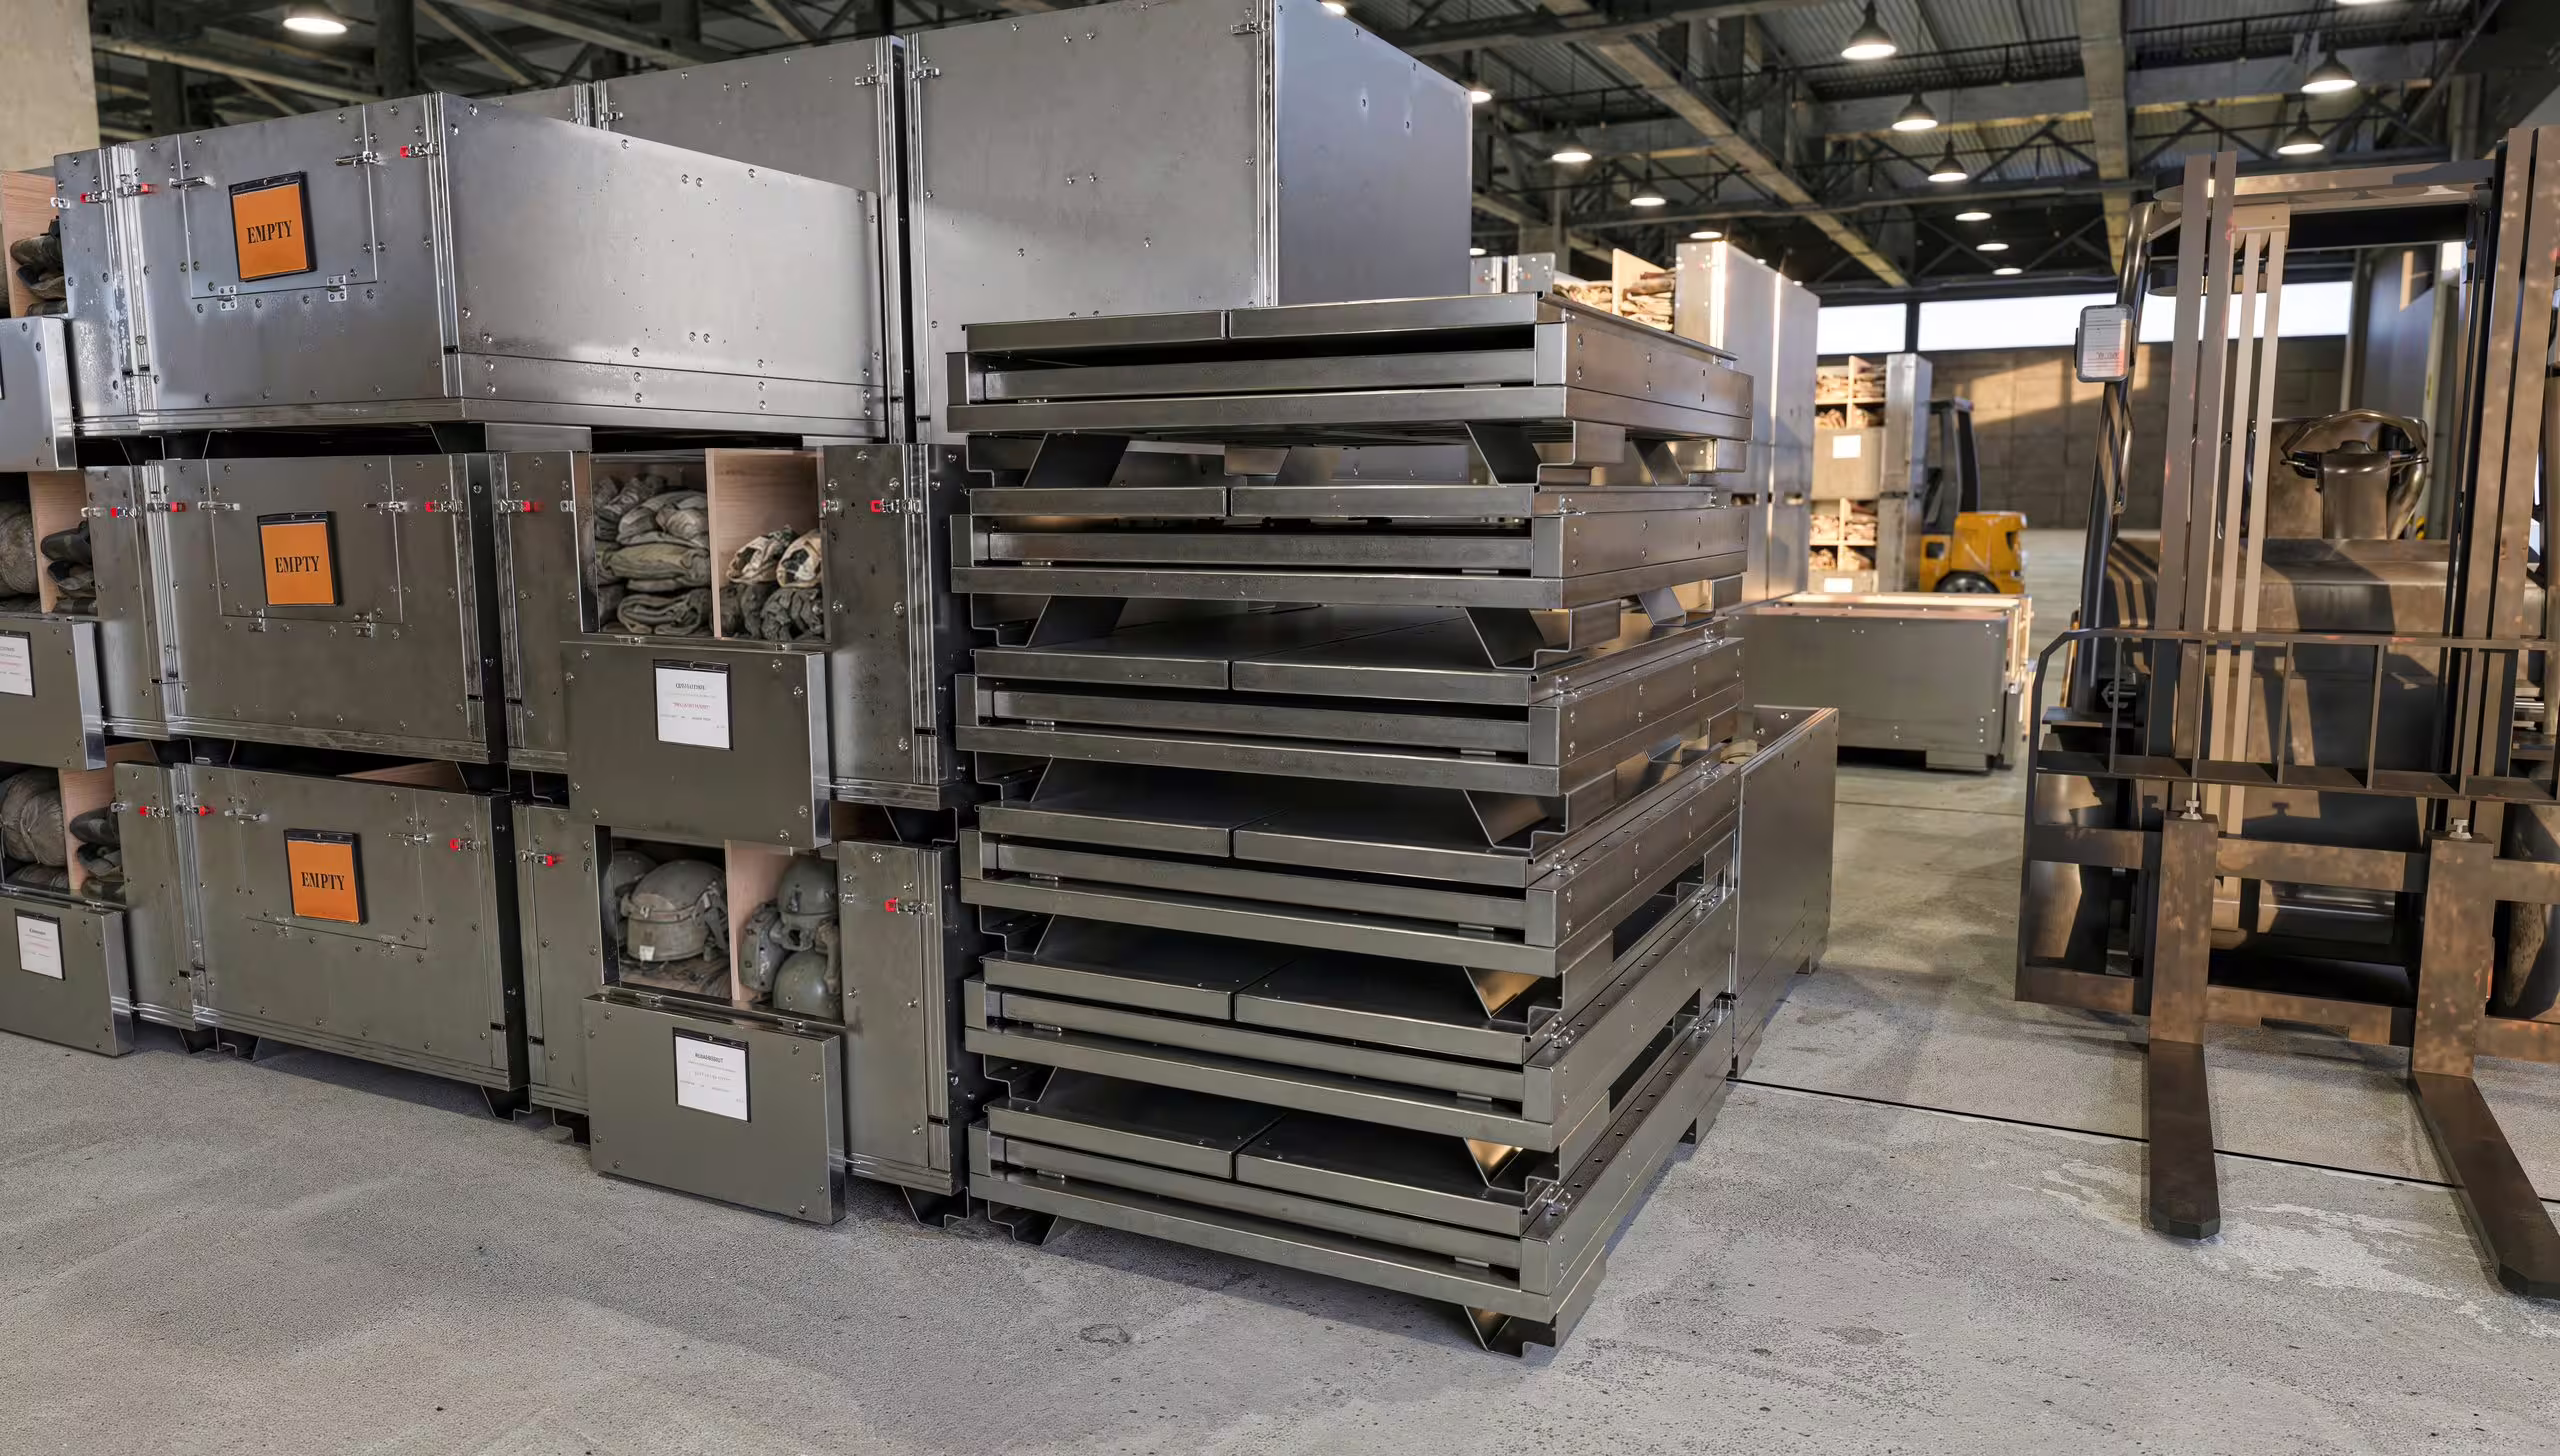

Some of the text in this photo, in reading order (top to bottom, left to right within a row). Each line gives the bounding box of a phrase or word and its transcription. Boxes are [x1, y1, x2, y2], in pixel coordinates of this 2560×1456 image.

[247, 220, 292, 244] EMPTY
[274, 556, 319, 573] EMPTY
[301, 872, 344, 890] EMPTY
